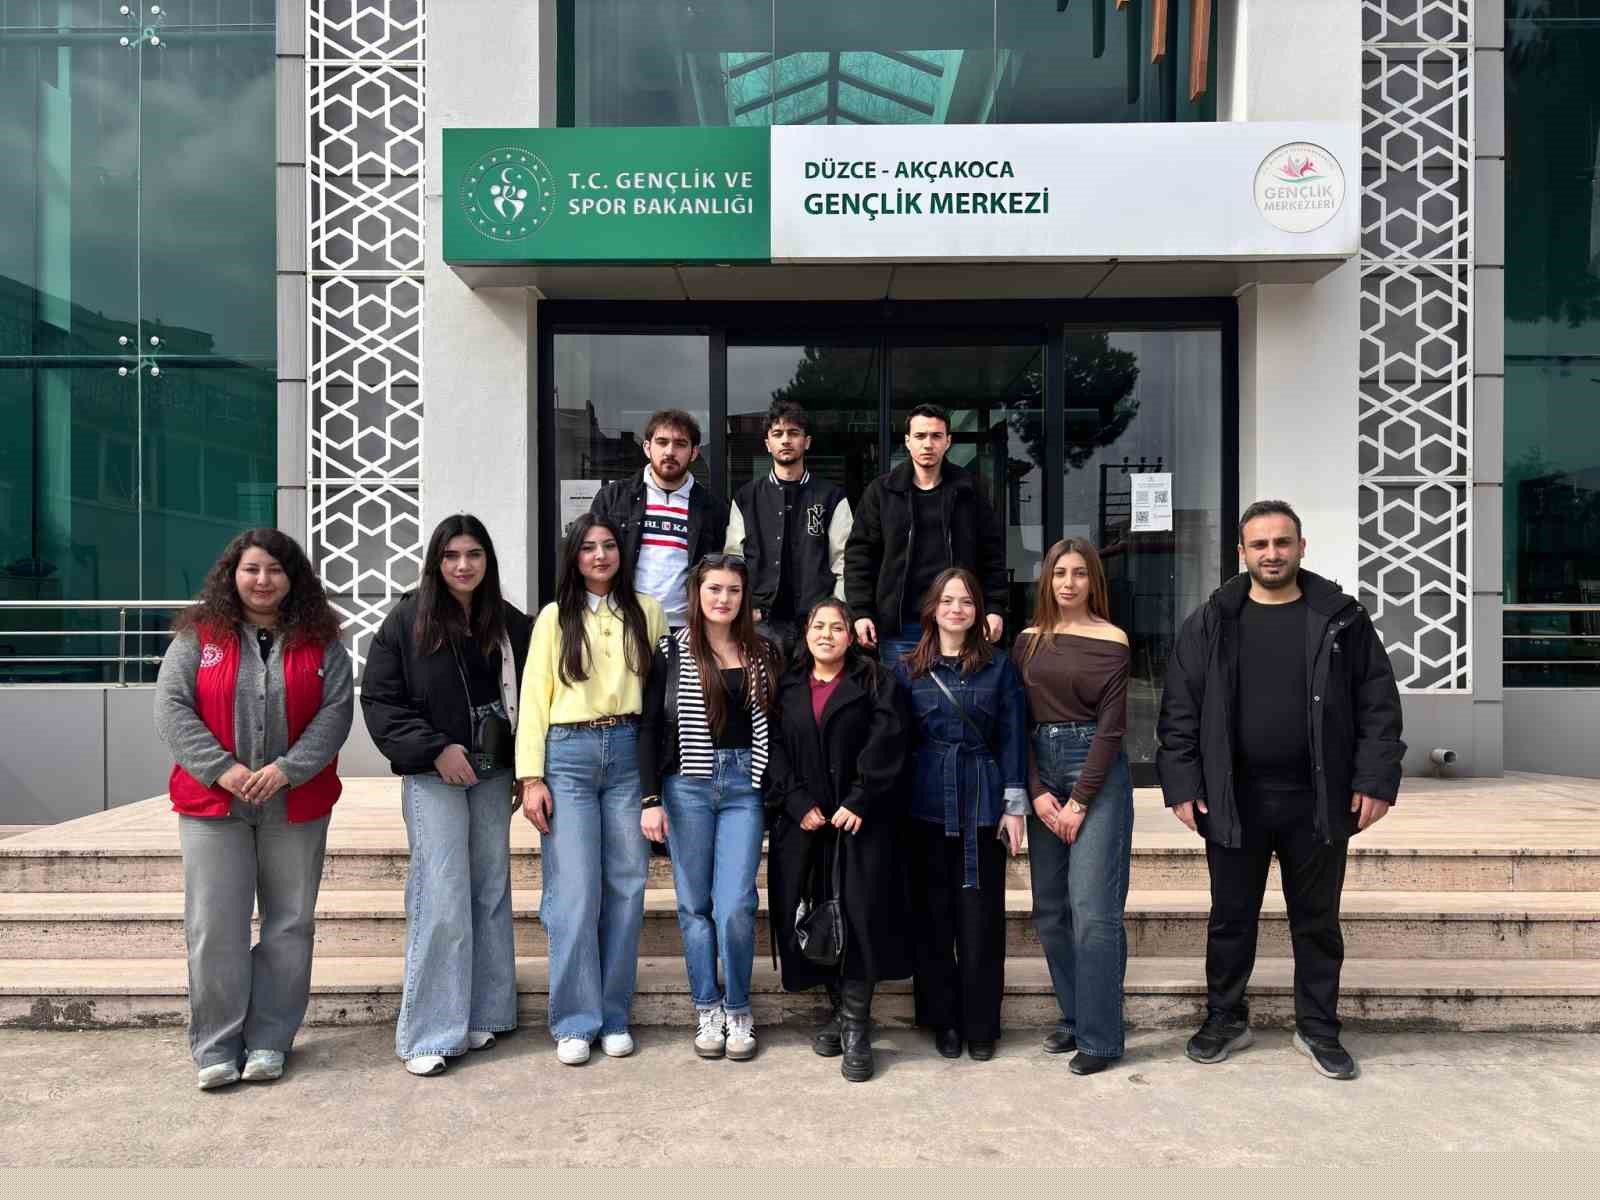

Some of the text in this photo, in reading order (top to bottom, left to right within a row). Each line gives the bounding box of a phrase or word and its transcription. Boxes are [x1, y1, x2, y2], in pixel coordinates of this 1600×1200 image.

[568, 168, 753, 194] T.C. GENÇLİK VE
[804, 157, 877, 179] DÜZCE
[894, 160, 1015, 183] AKÇAKOCA
[568, 194, 753, 215] SPOR BAKANLIĞI
[804, 187, 1049, 220] GENÇLİK MERKEZİ
[644, 520, 688, 533] RL KA
